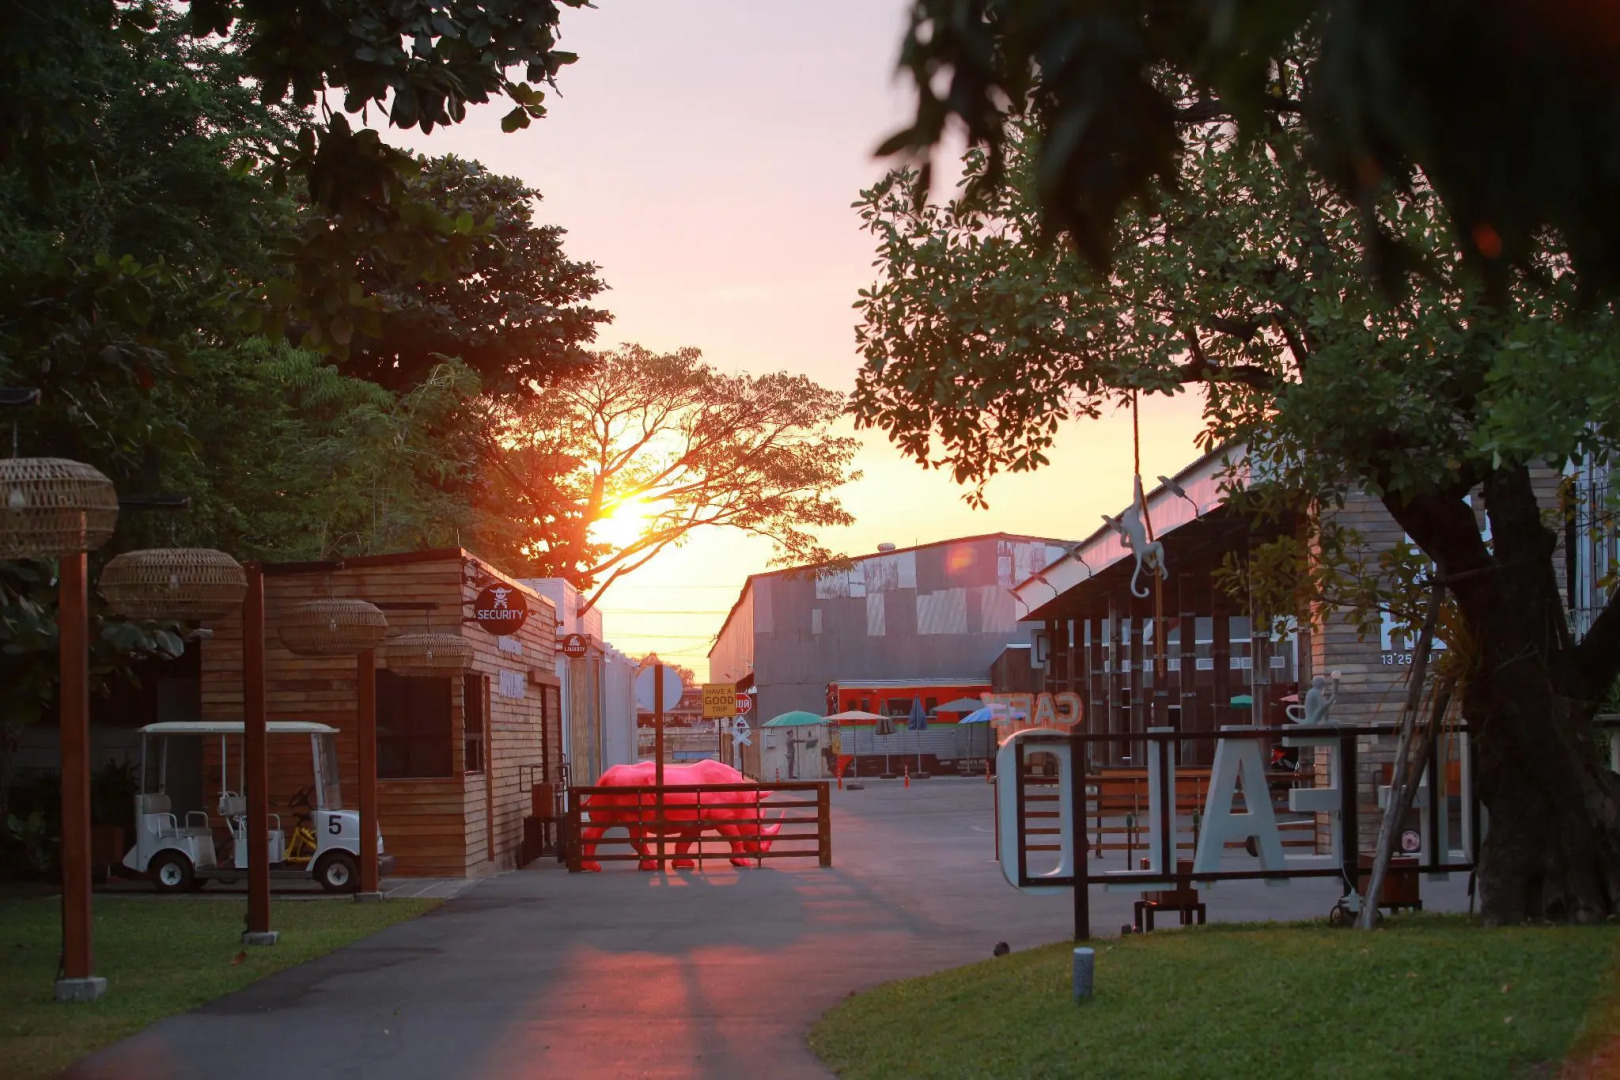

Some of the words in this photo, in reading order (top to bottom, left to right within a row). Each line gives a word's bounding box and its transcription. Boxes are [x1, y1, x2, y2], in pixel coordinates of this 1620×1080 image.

[477, 608, 524, 620] SECURITY
[705, 697, 734, 705] GOOD
[328, 815, 342, 835] 5
